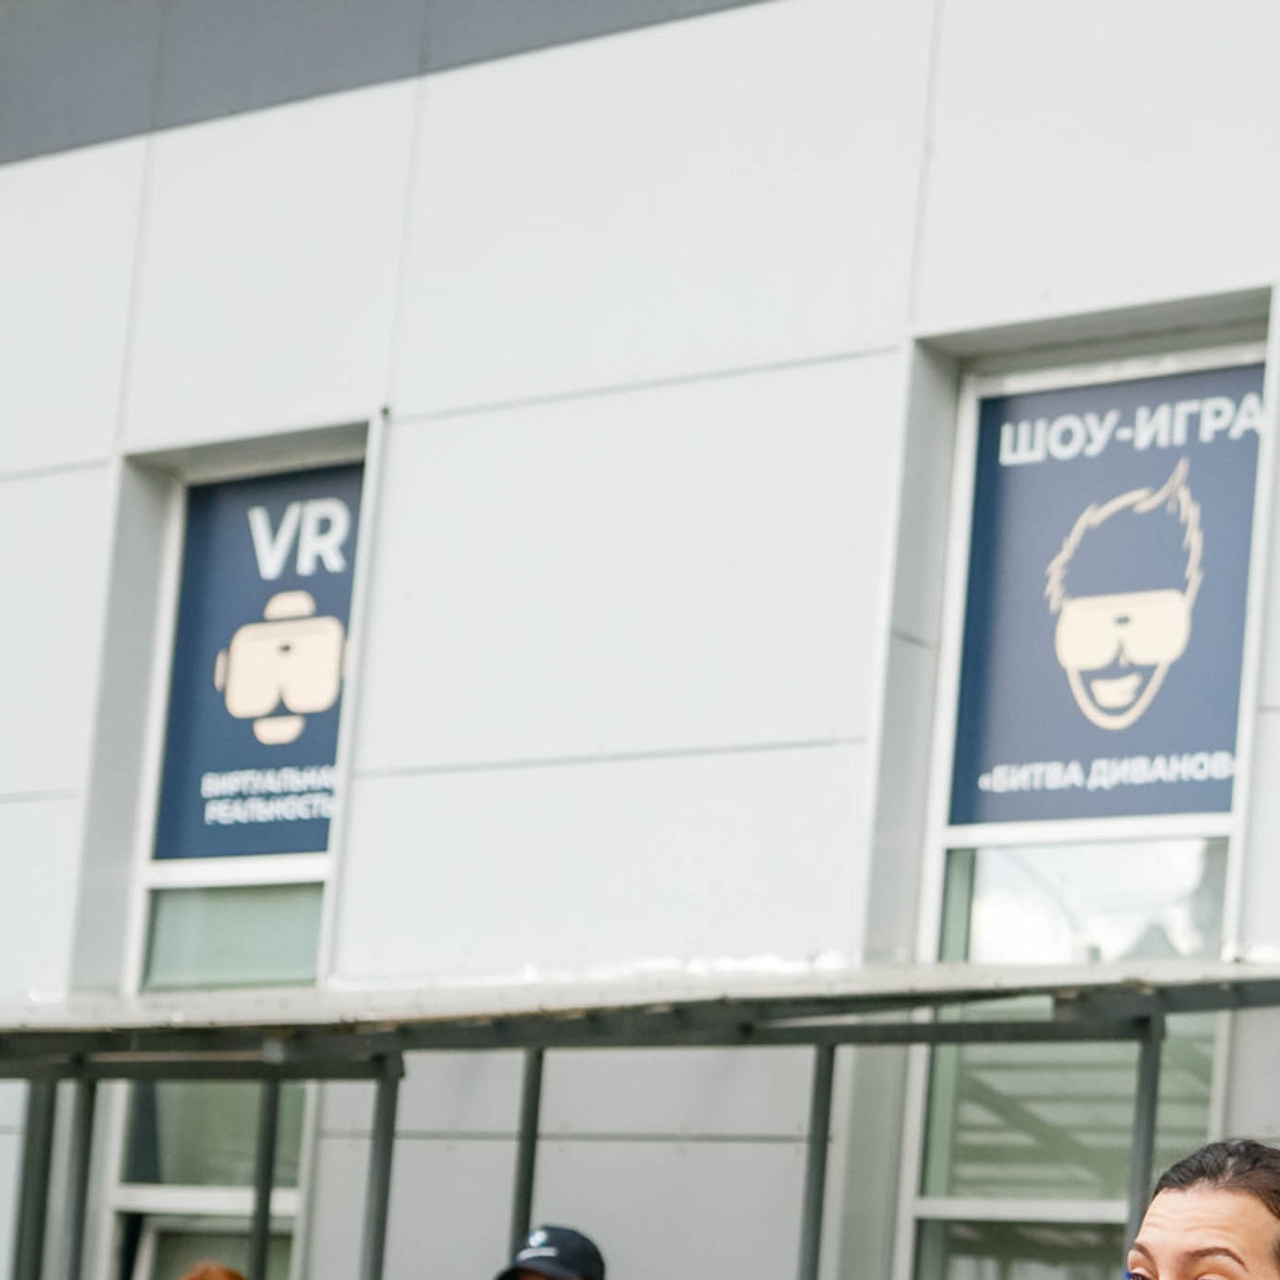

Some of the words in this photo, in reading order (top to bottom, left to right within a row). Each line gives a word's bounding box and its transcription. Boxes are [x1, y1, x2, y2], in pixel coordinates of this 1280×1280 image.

[999, 392, 1262, 466] ШОУ-ИГРА
[248, 497, 350, 580] VR
[1086, 750, 1235, 791] ДИВАНОВ
